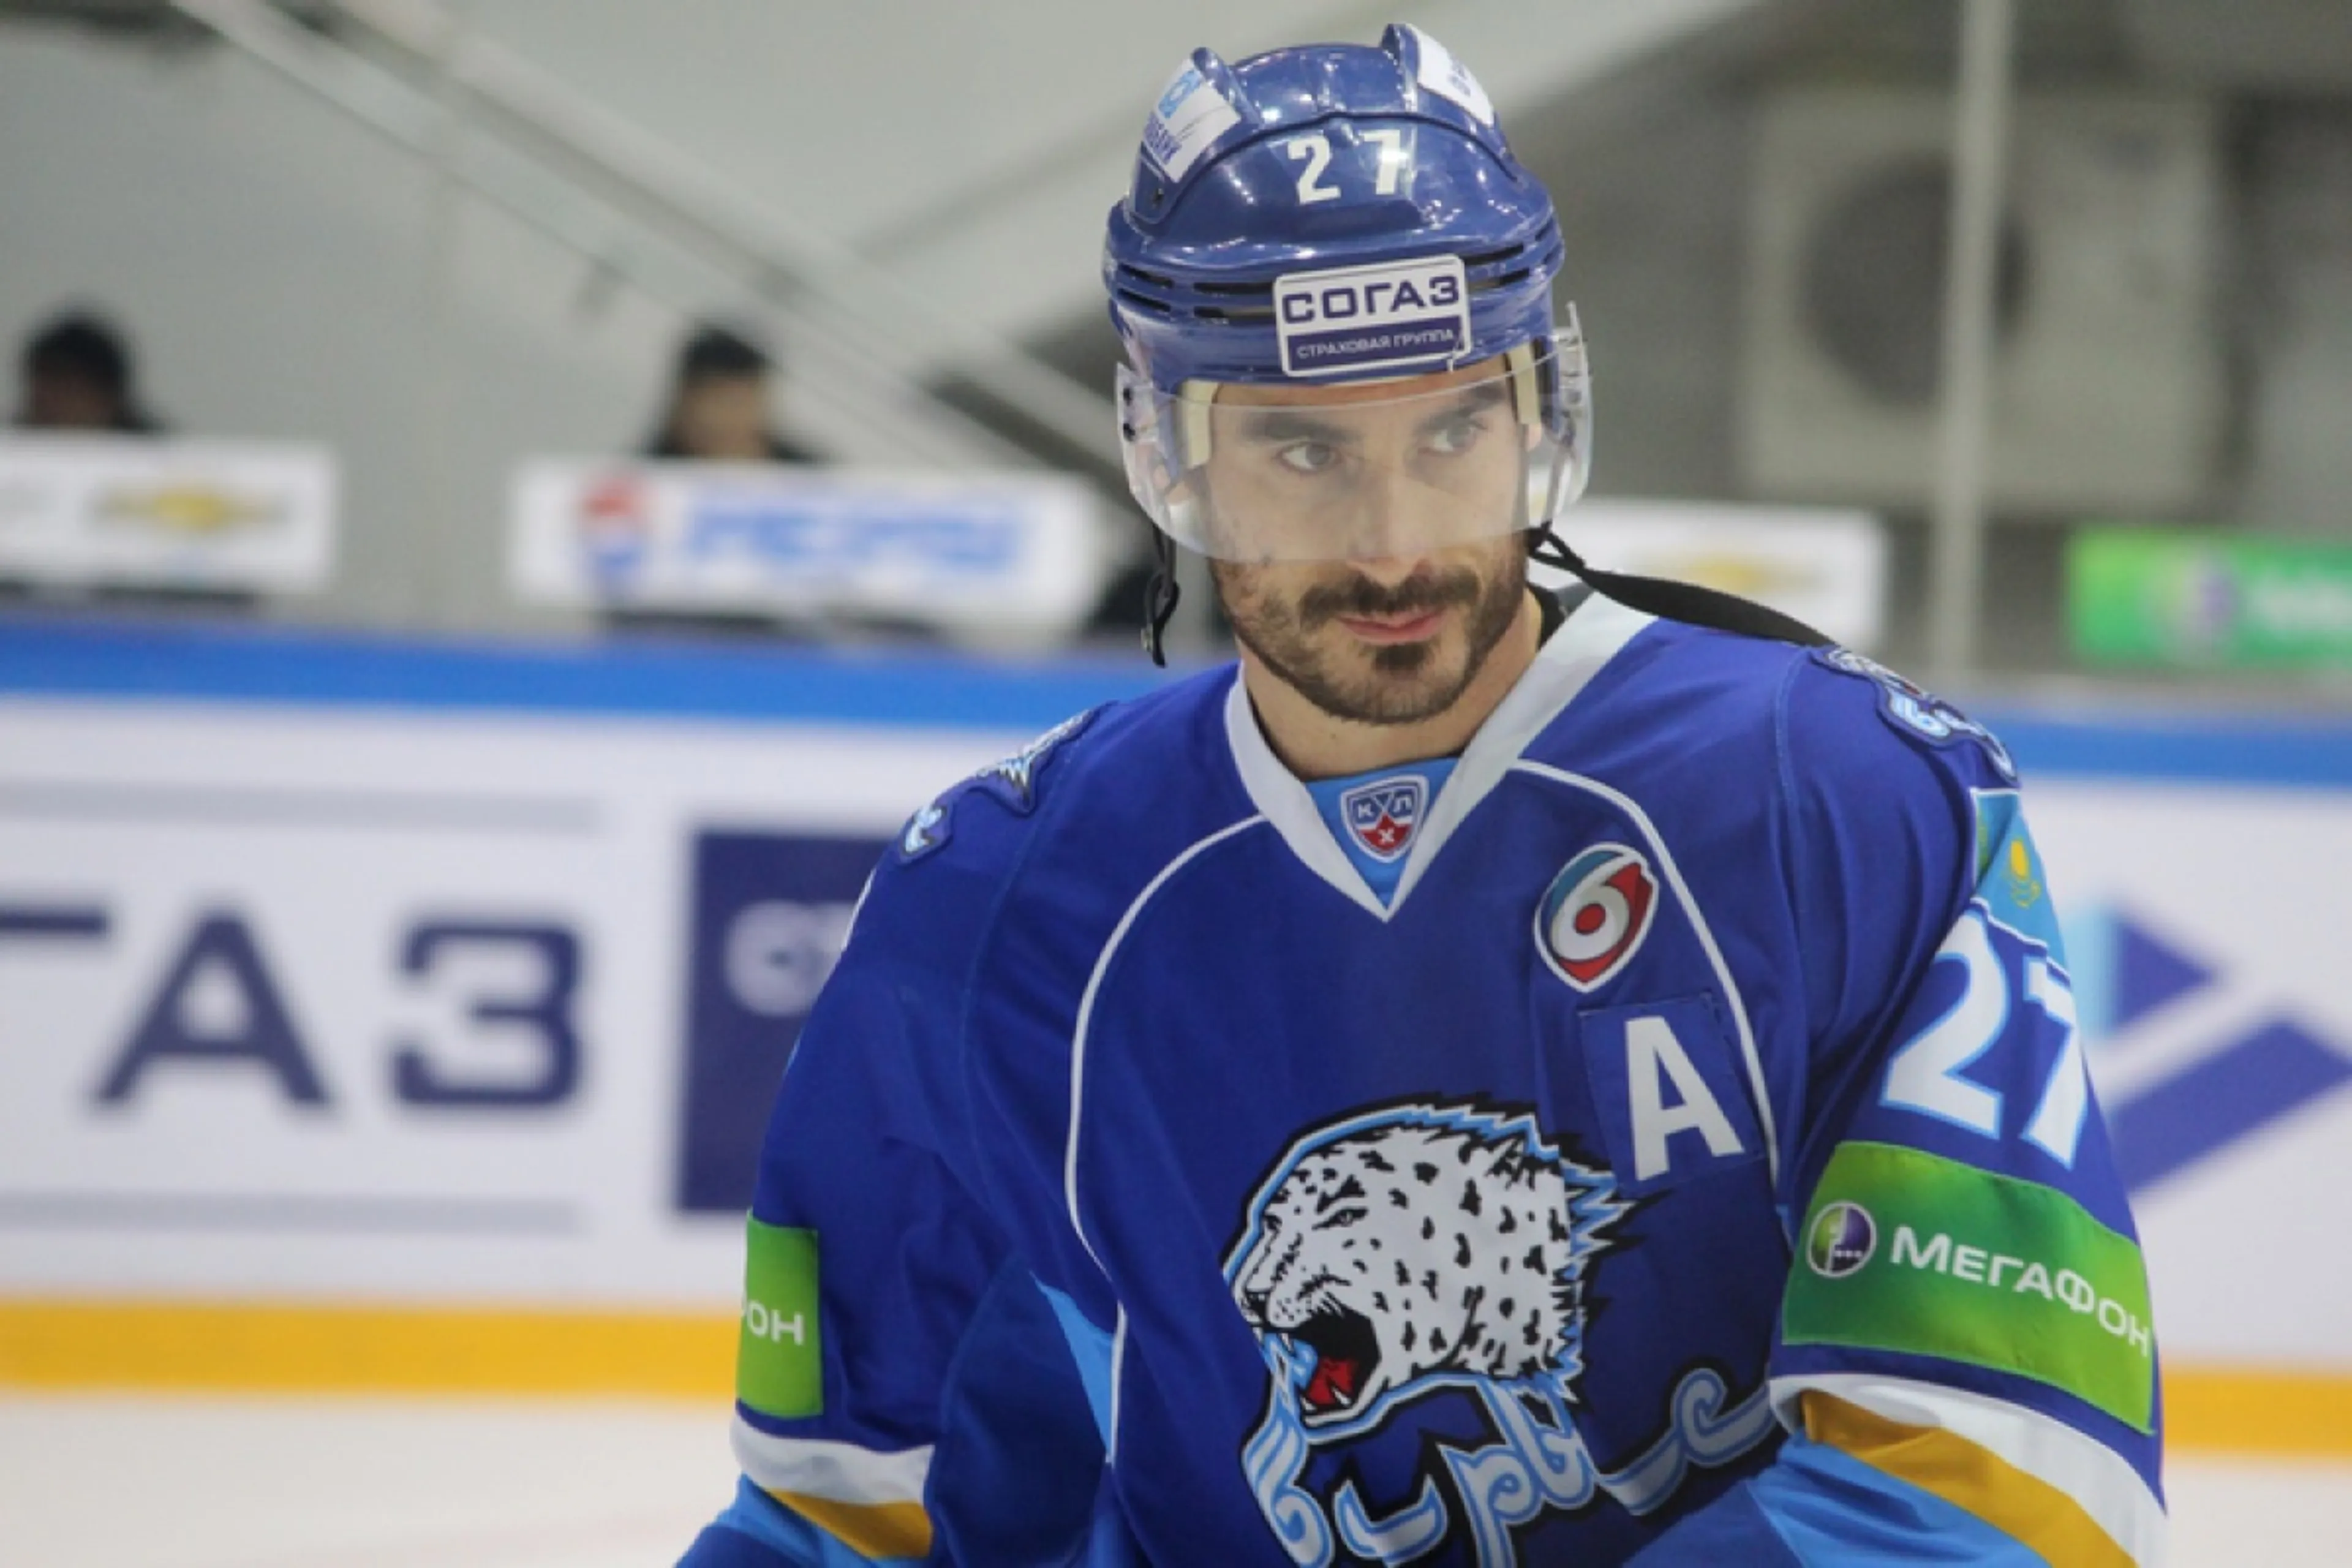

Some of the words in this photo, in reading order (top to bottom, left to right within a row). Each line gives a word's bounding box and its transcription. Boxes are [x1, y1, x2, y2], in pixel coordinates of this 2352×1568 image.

[1287, 129, 1401, 205] 27
[1282, 276, 1460, 324] СОГАЗ
[1296, 337, 1391, 360] СТРАХОВАЯ
[1393, 329, 1454, 347] ГРУППА
[1879, 910, 2088, 1171] 27
[741, 1298, 804, 1346] ОН
